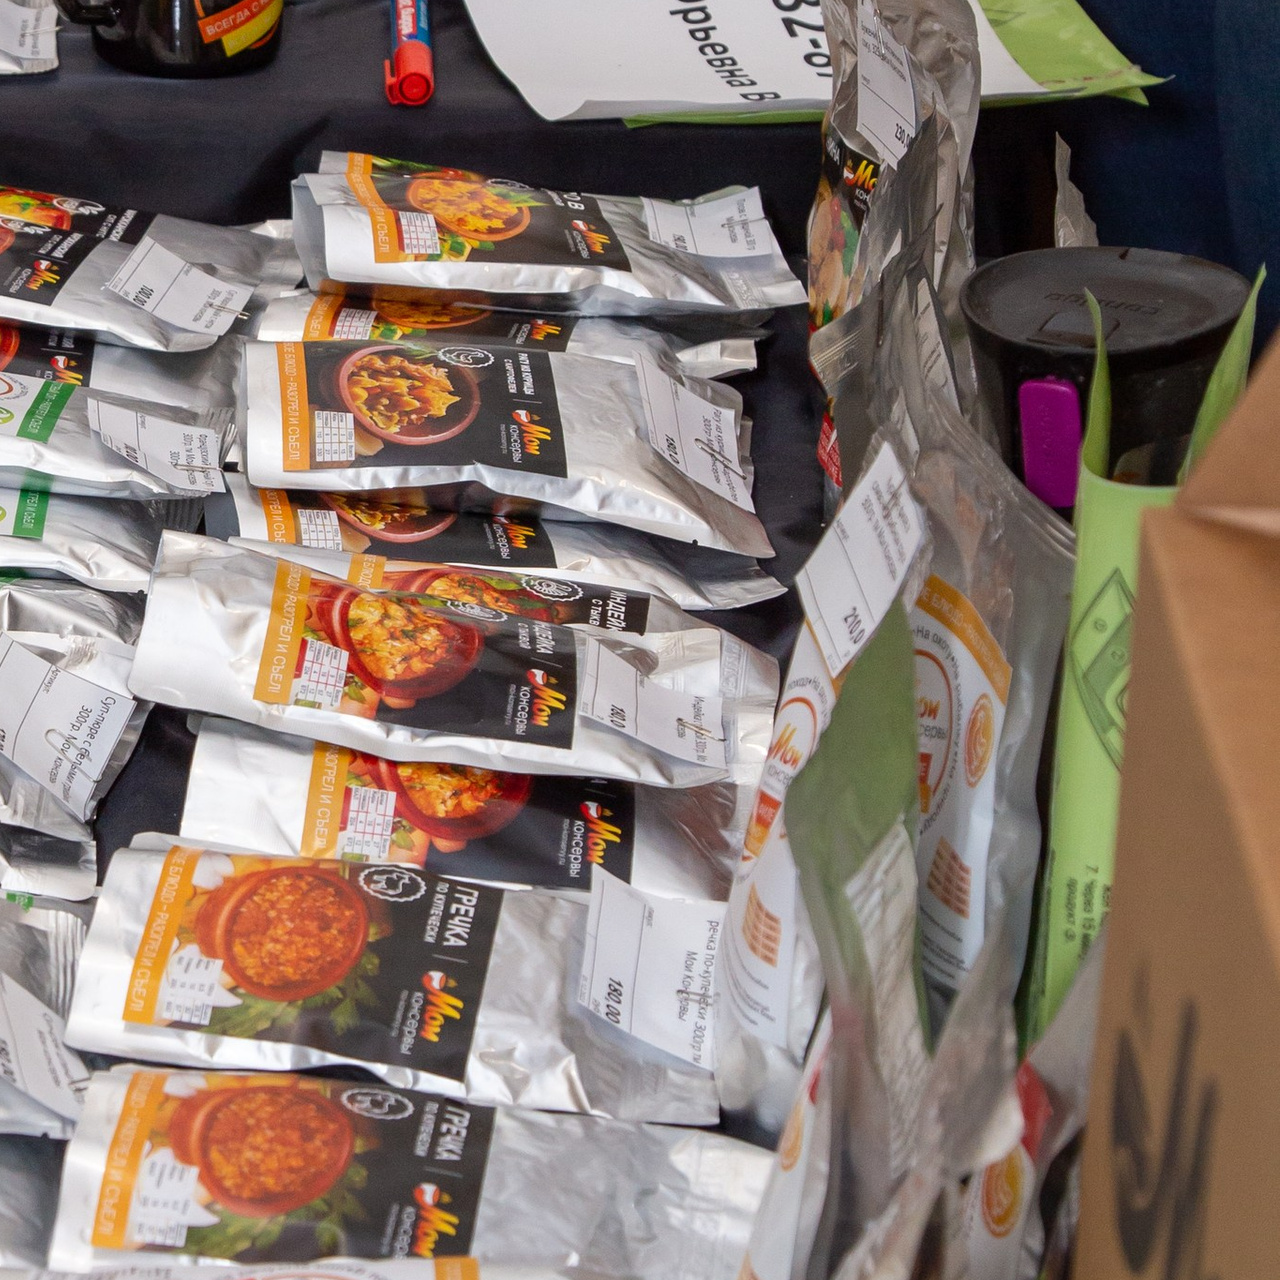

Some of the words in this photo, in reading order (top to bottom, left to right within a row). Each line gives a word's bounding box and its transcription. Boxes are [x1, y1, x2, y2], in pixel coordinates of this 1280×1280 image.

[206, 8, 251, 36] ВСЕГДА
[375, 224, 390, 253] СЪЕЛ!
[572, 230, 591, 259] консервы
[581, 227, 610, 254] Мои
[25, 267, 61, 289] Мои
[133, 284, 154, 306] 100,00
[530, 323, 561, 340] Мои
[285, 355, 298, 374] БЛЮДО
[518, 353, 531, 366] РАГУ
[504, 364, 517, 393] КАРТОФЕЛЕМ
[520, 374, 535, 395] КУРИЦЫ
[286, 383, 300, 414] РАЗОГРЕЛ
[713, 408, 723, 422] Рагу
[287, 426, 300, 460] СЪЕЛ!
[521, 422, 551, 454] Мои
[702, 416, 713, 437] 300гр
[508, 425, 523, 463] консервы
[500, 521, 530, 549] Мои
[276, 595, 299, 638] РАЗОГРЕЛ
[519, 631, 533, 649] ТЫКВОЙ
[269, 657, 289, 693] СЪЕЛ!
[69, 705, 93, 732] 300гр.
[87, 696, 116, 740] Суп-пюре
[514, 686, 533, 735] консервы
[531, 682, 566, 726] Мои
[768, 724, 803, 770] Мои
[568, 821, 586, 878] консервы
[585, 815, 622, 863] Мои
[157, 868, 181, 903] БЛЮДО
[1083, 879, 1096, 914] Через
[424, 896, 447, 943] КУПЕЧЕСКИ
[441, 886, 479, 947] ГРЕЧКА
[684, 950, 698, 972] Мои
[128, 969, 152, 1012] СЪЕЛ!
[605, 977, 623, 1025] 180,00
[399, 991, 426, 1054] консервы
[419, 983, 463, 1042] Мои
[432, 1110, 471, 1161] ГРЕЧКА
[415, 1201, 459, 1258] Мои
